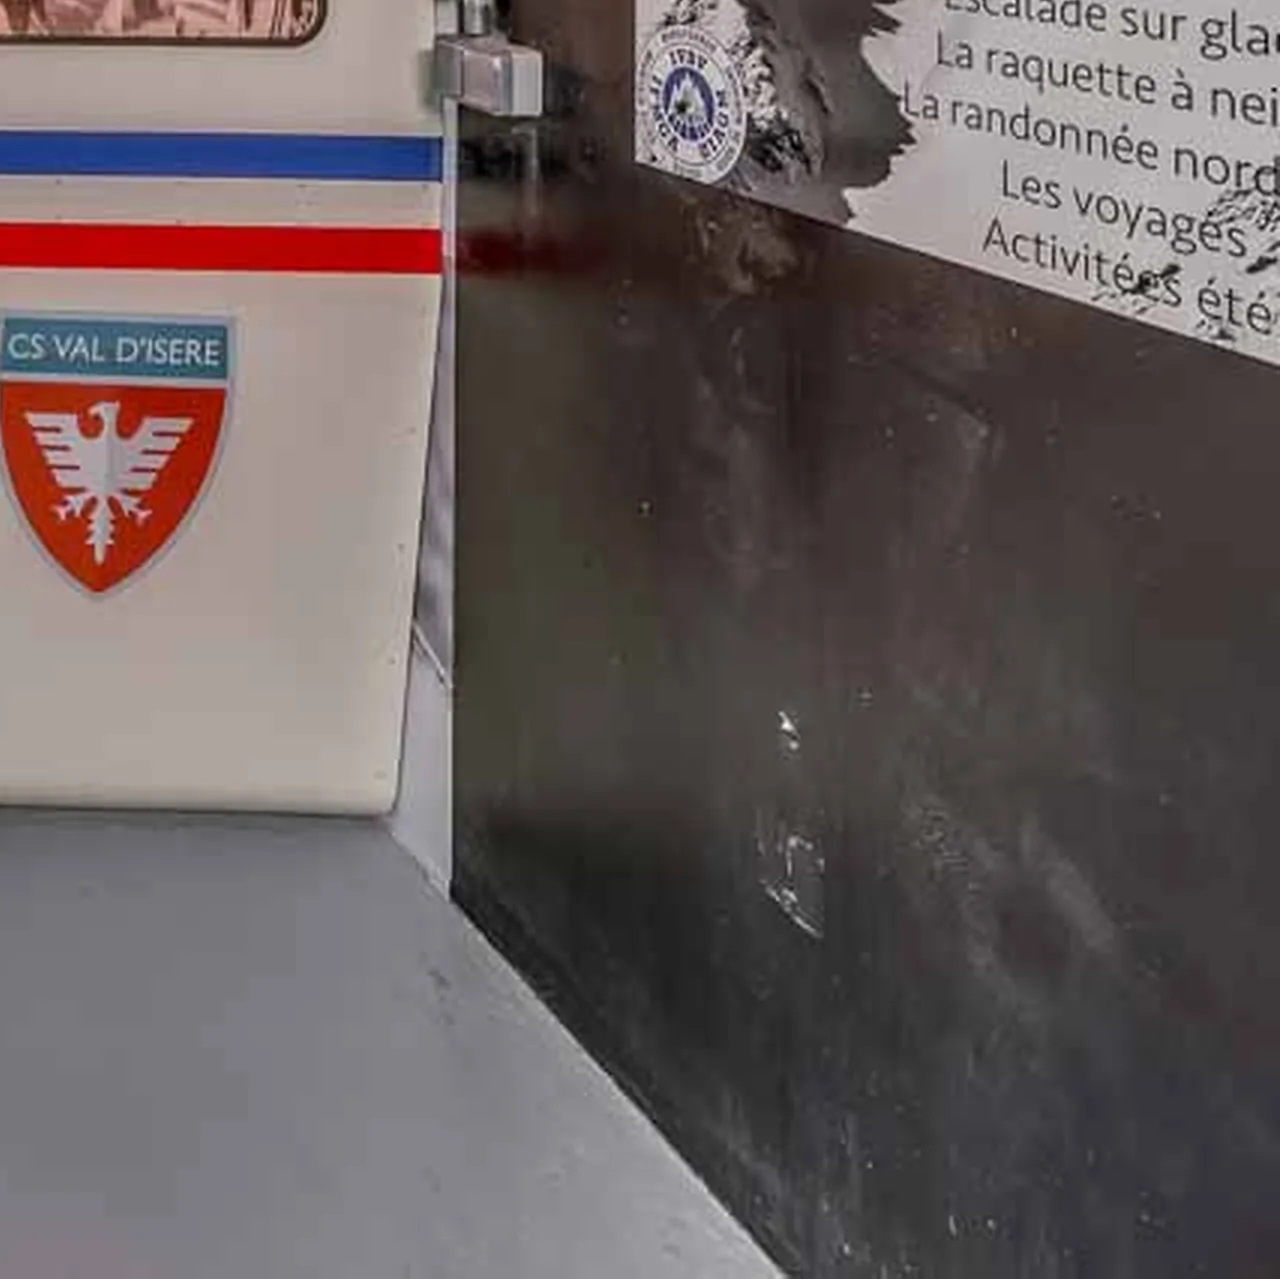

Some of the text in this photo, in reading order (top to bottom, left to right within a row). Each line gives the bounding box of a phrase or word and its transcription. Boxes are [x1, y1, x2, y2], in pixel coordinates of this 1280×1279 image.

[936, 29, 974, 70] La
[986, 48, 1157, 105] raquette
[1170, 68, 1194, 112] à
[1120, 6, 1188, 43] sur
[1199, 9, 1280, 61] gla
[903, 78, 939, 121] La
[951, 102, 1160, 171] randonnée
[1002, 159, 1248, 258] Les voyages
[7, 333, 221, 366] CS VAL D'ISERE
